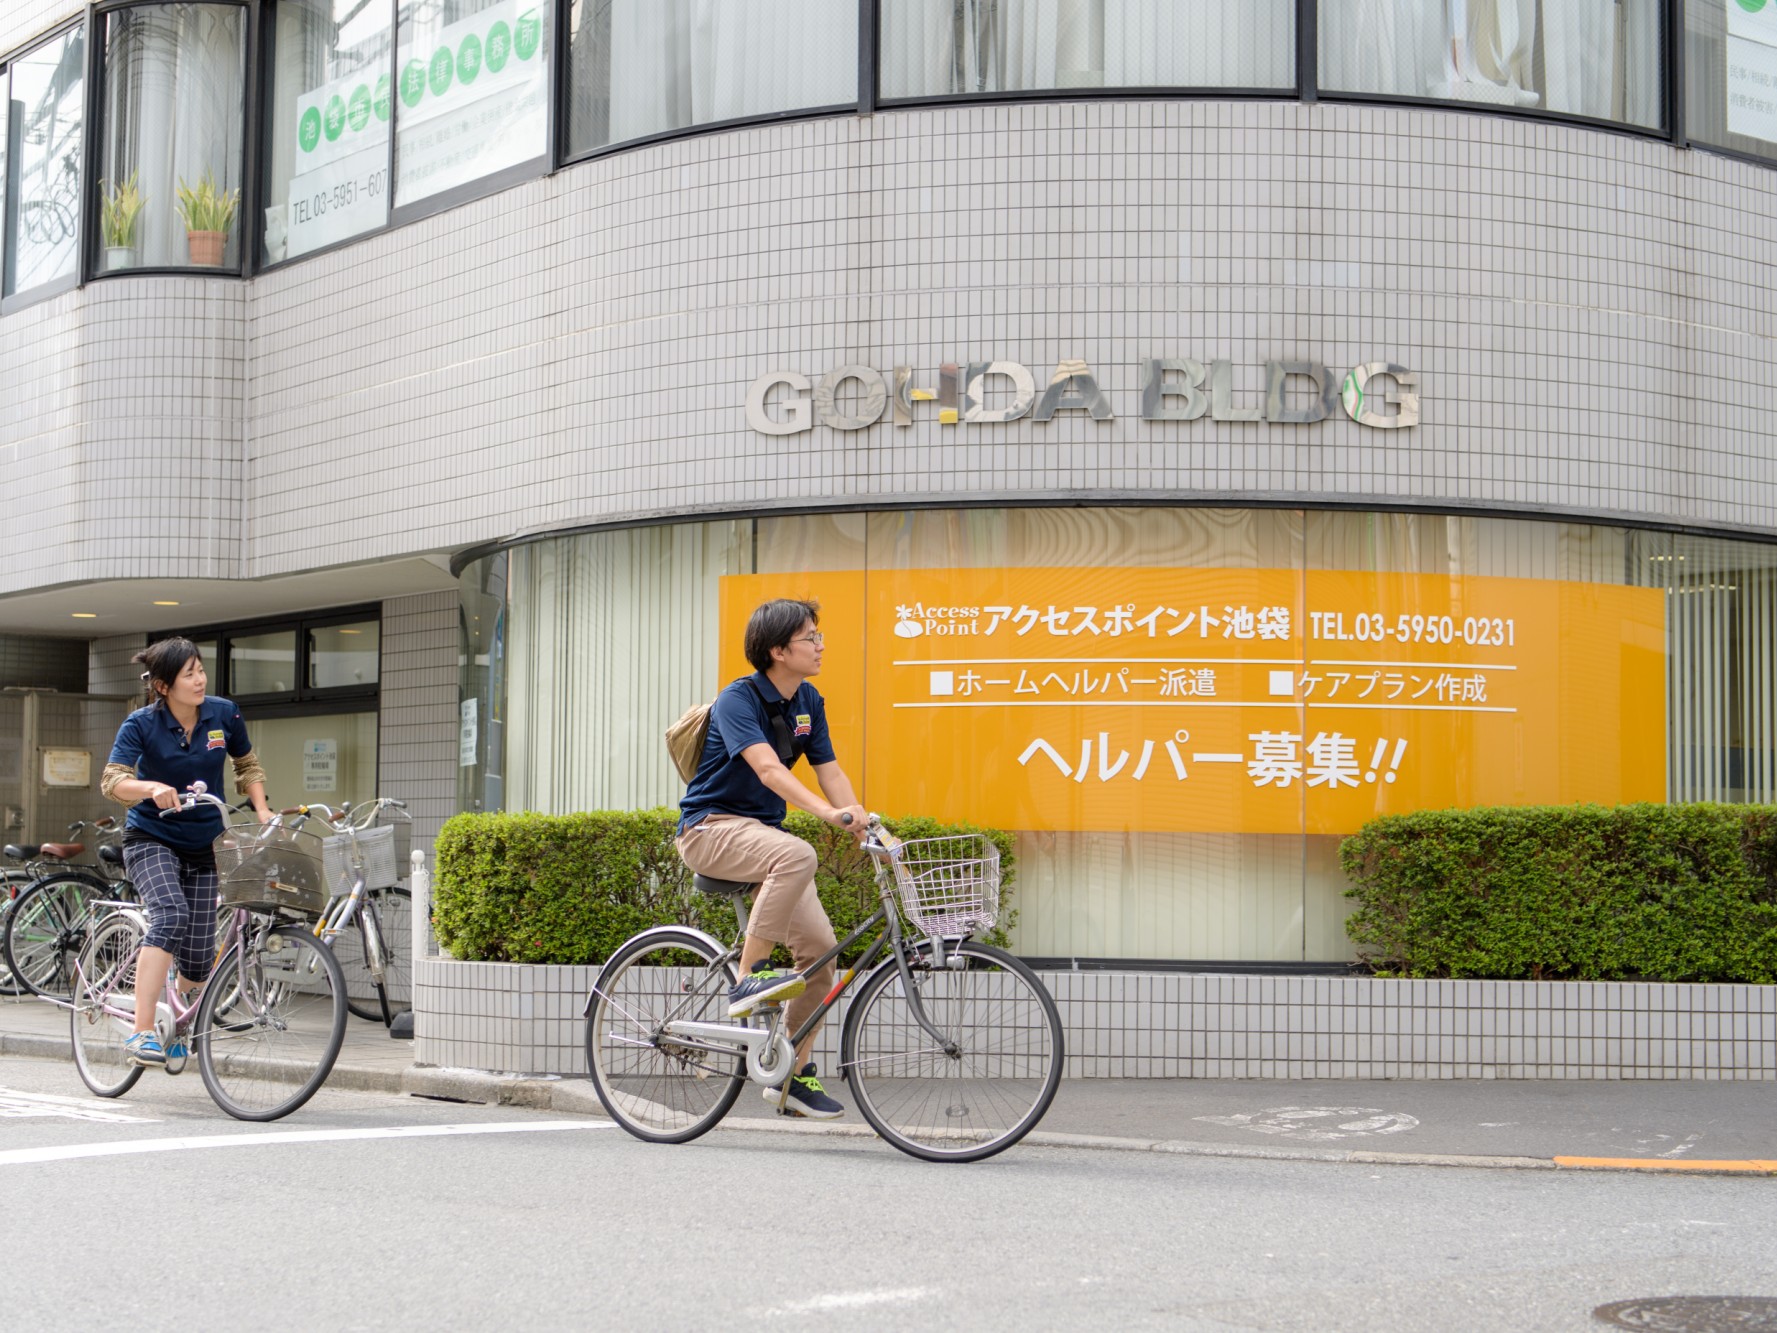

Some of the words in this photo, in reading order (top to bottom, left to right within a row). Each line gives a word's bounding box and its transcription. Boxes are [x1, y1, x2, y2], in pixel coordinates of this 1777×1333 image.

[745, 360, 1115, 436] GOHDA
[1141, 358, 1420, 429] BLDG
[912, 602, 980, 619] Access
[925, 619, 978, 636] Point
[983, 603, 1290, 641] アクセスポイント池袋
[1310, 611, 1515, 647] TEL.03-5950-0231
[1297, 669, 1487, 702] ケアプラン作成
